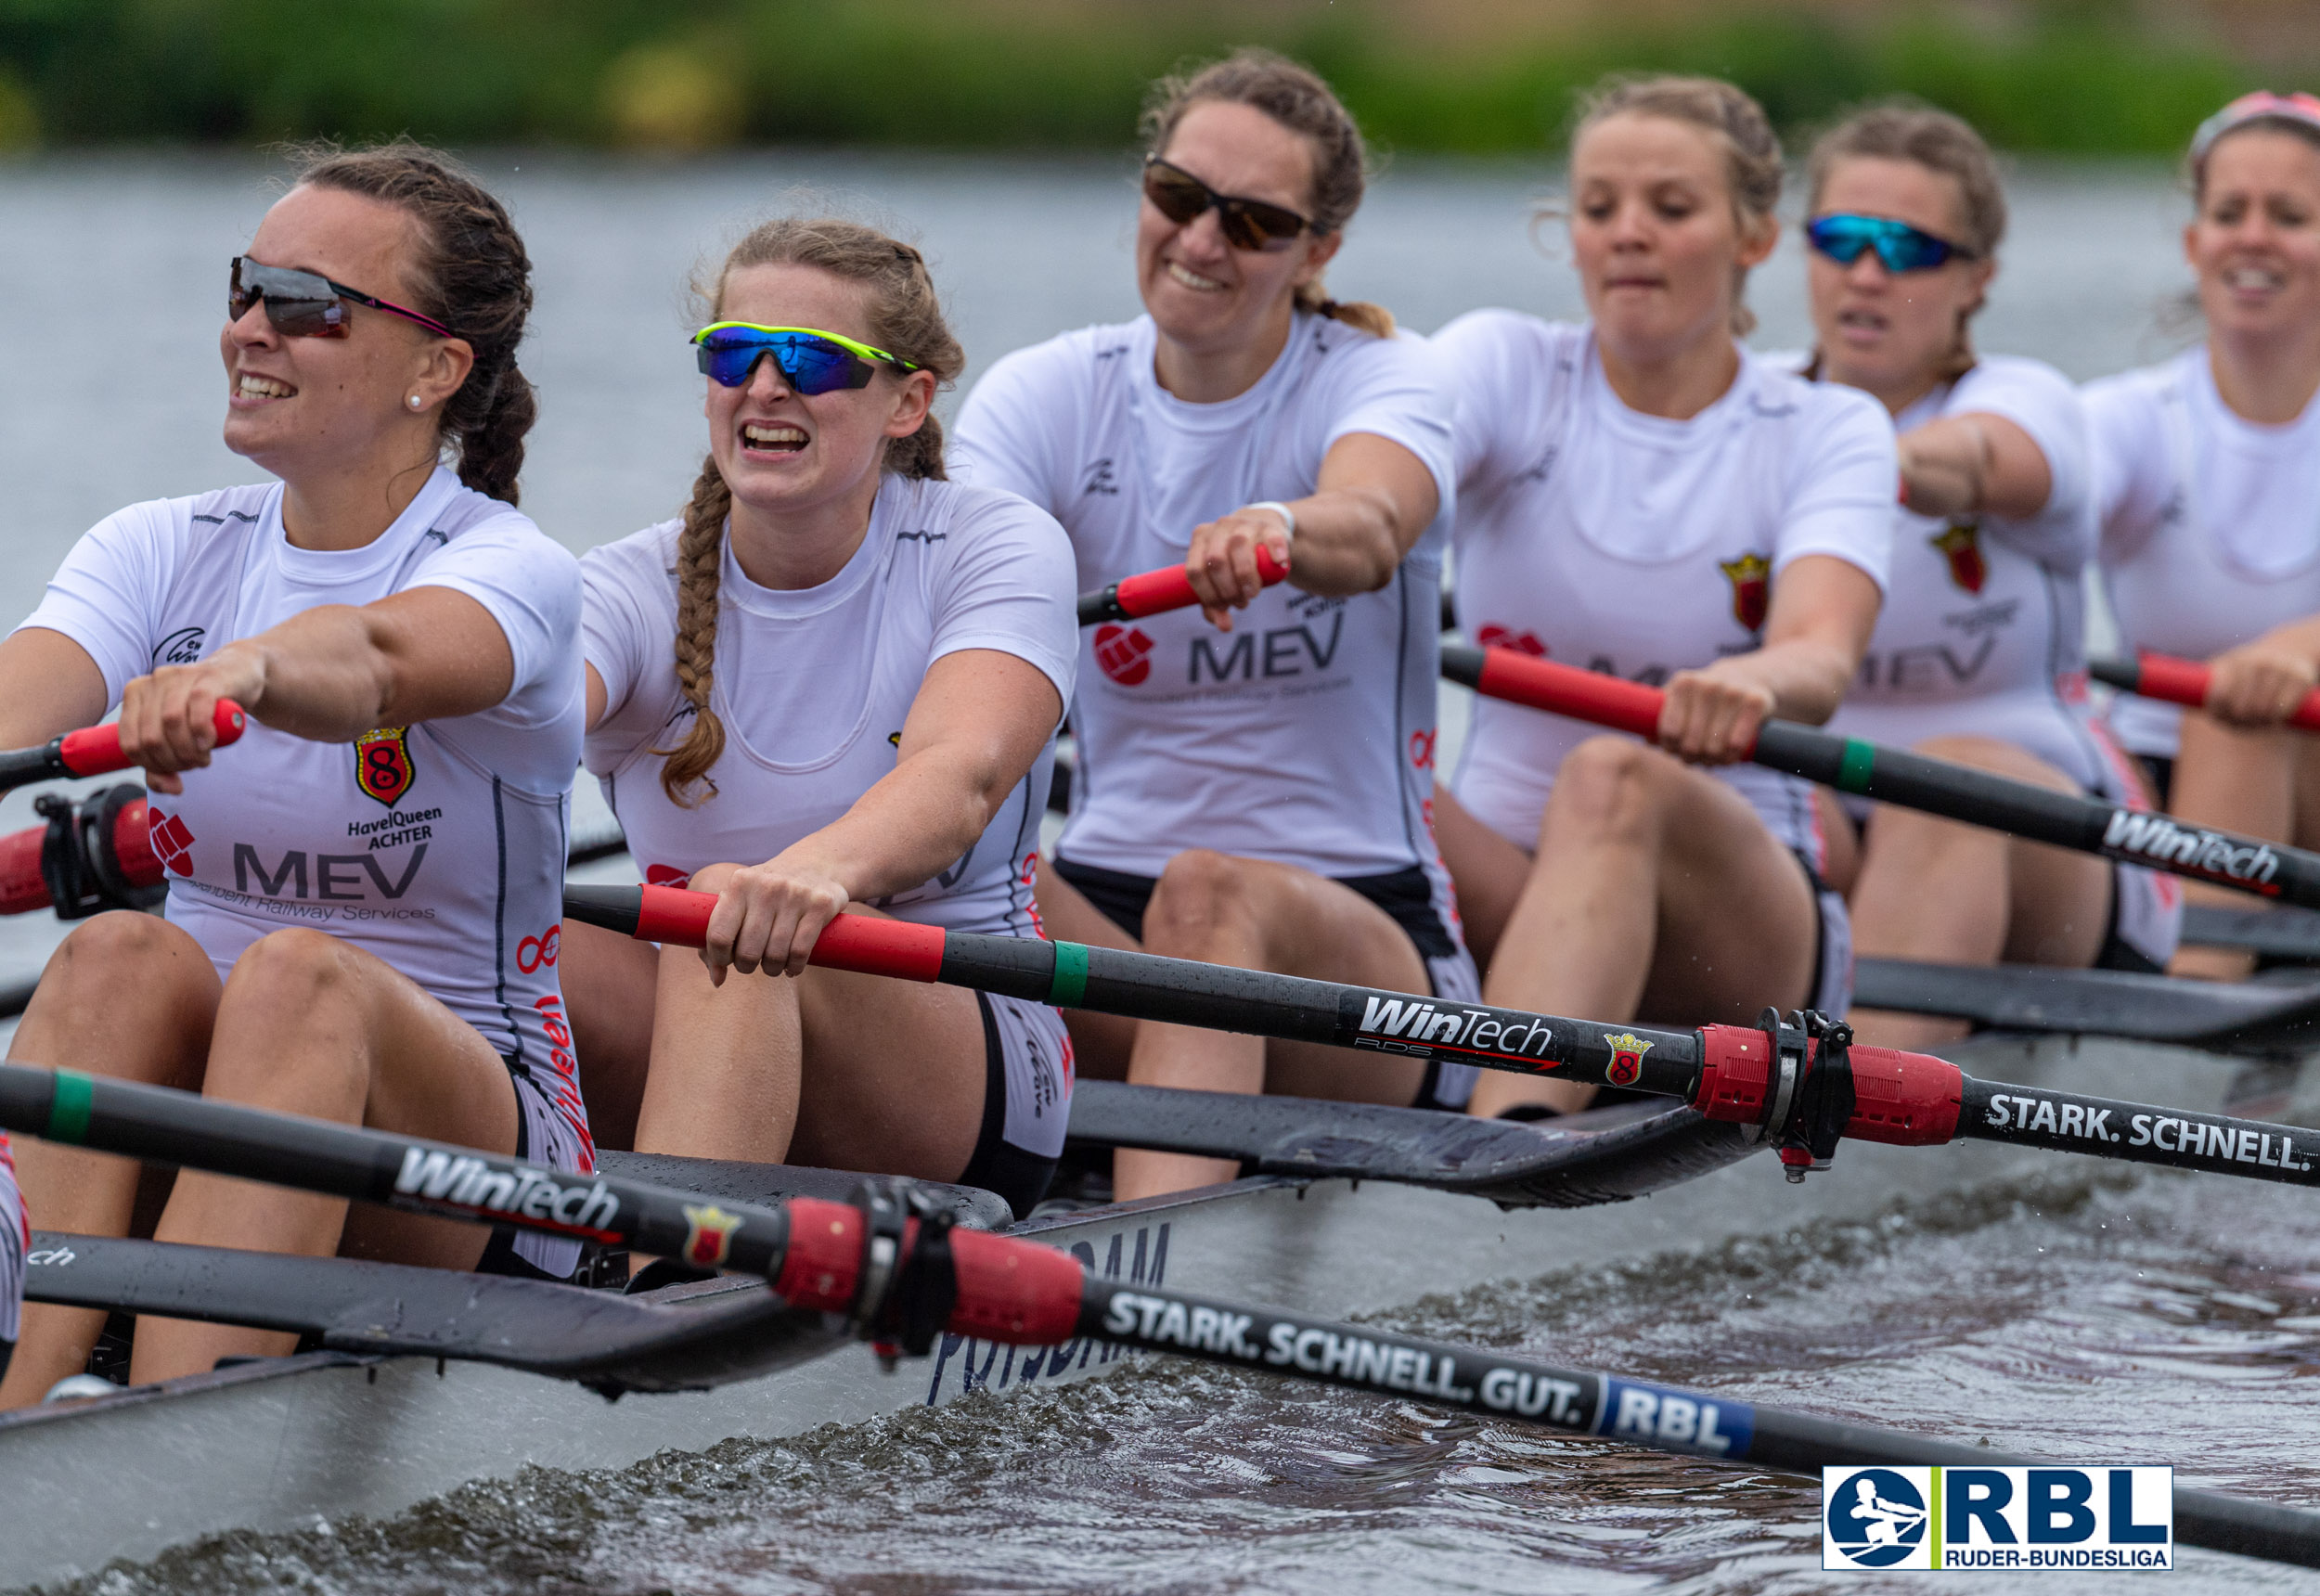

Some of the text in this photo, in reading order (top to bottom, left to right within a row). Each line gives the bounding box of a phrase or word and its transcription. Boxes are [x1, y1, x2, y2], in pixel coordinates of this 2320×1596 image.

[1188, 610, 1344, 685] MEV
[347, 806, 444, 837] HavelQueen
[367, 825, 433, 852] ACHTER
[2103, 808, 2280, 884] WinTech
[234, 842, 429, 900] MEV
[255, 895, 336, 922] Railway
[342, 904, 436, 921] Services
[1354, 1037, 1434, 1057] RDS
[1359, 996, 1553, 1057] WinTech
[1987, 1093, 2312, 1172] STARK. SCHNELL.
[394, 1147, 620, 1231] WinTech
[1106, 1290, 1732, 1452] STARK. SCHNELL. GUT. RBL
